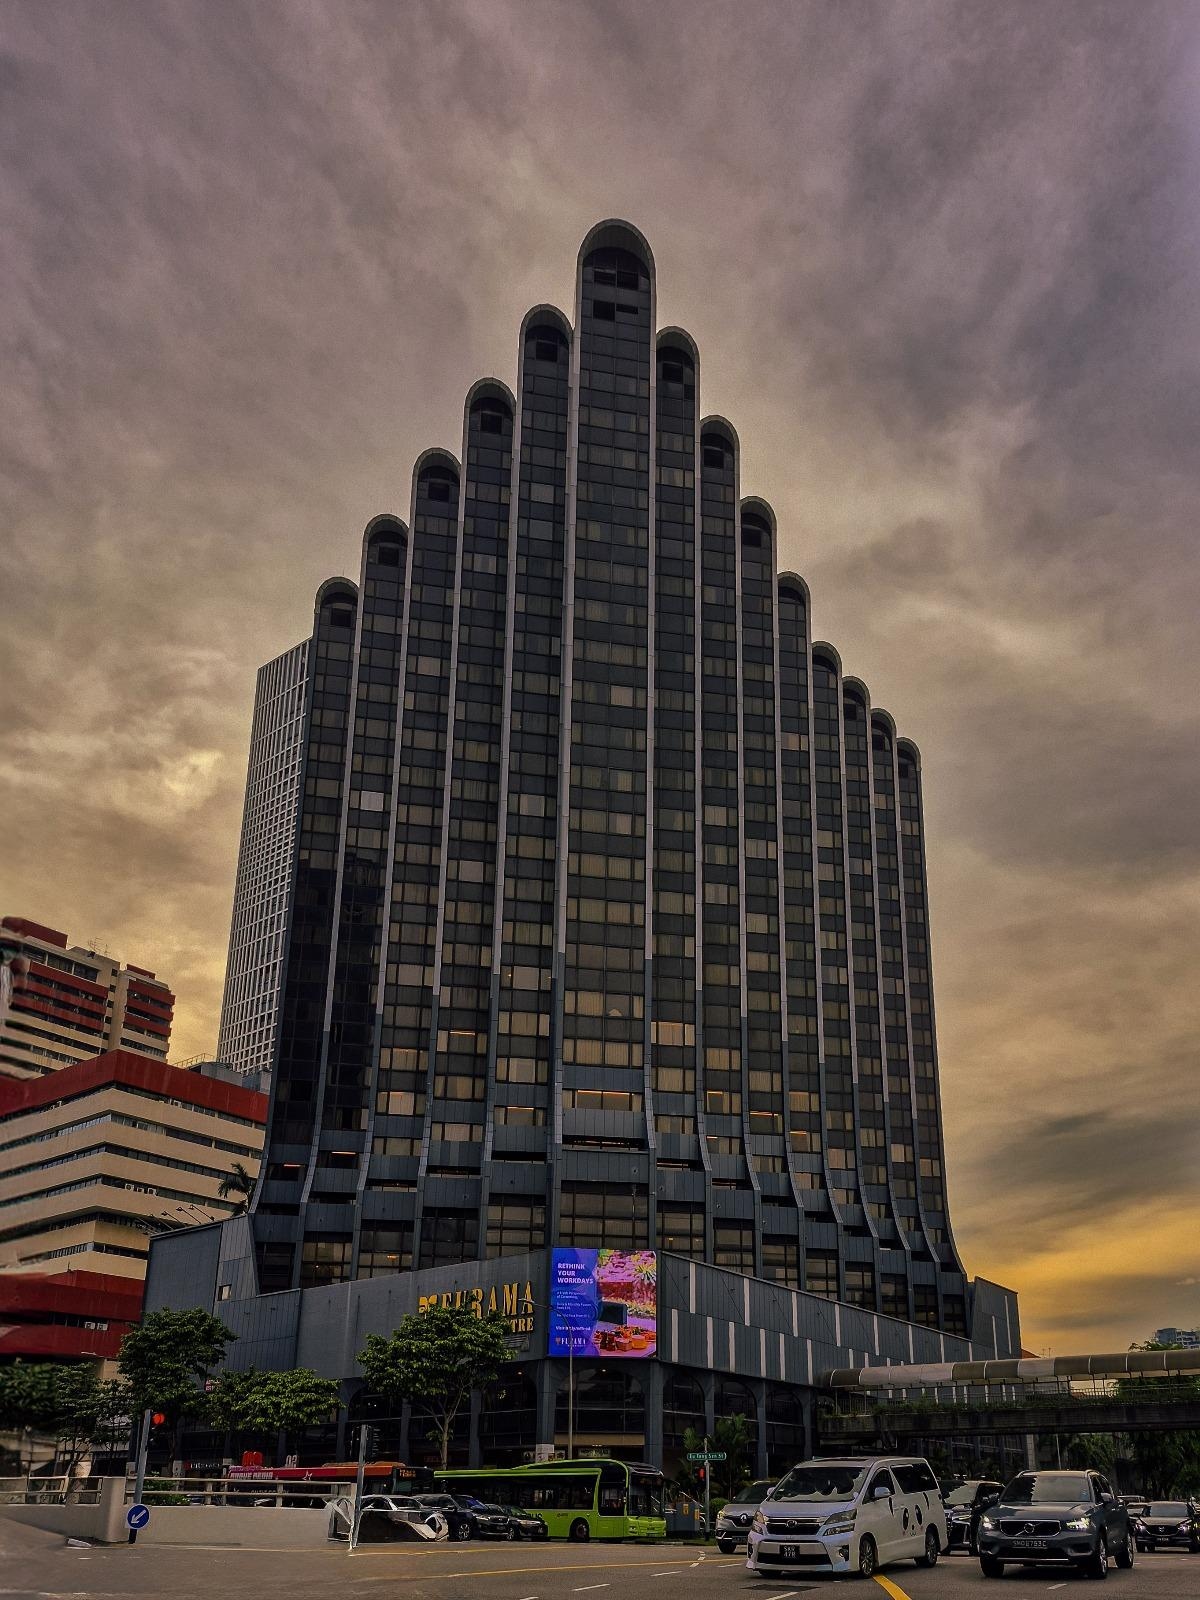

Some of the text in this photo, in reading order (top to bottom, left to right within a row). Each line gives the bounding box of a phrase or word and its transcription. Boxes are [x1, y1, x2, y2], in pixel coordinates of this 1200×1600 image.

[557, 1262, 585, 1270] RETHINK
[441, 1281, 534, 1320] FURAMA
[561, 1337, 586, 1345] FUAMA
